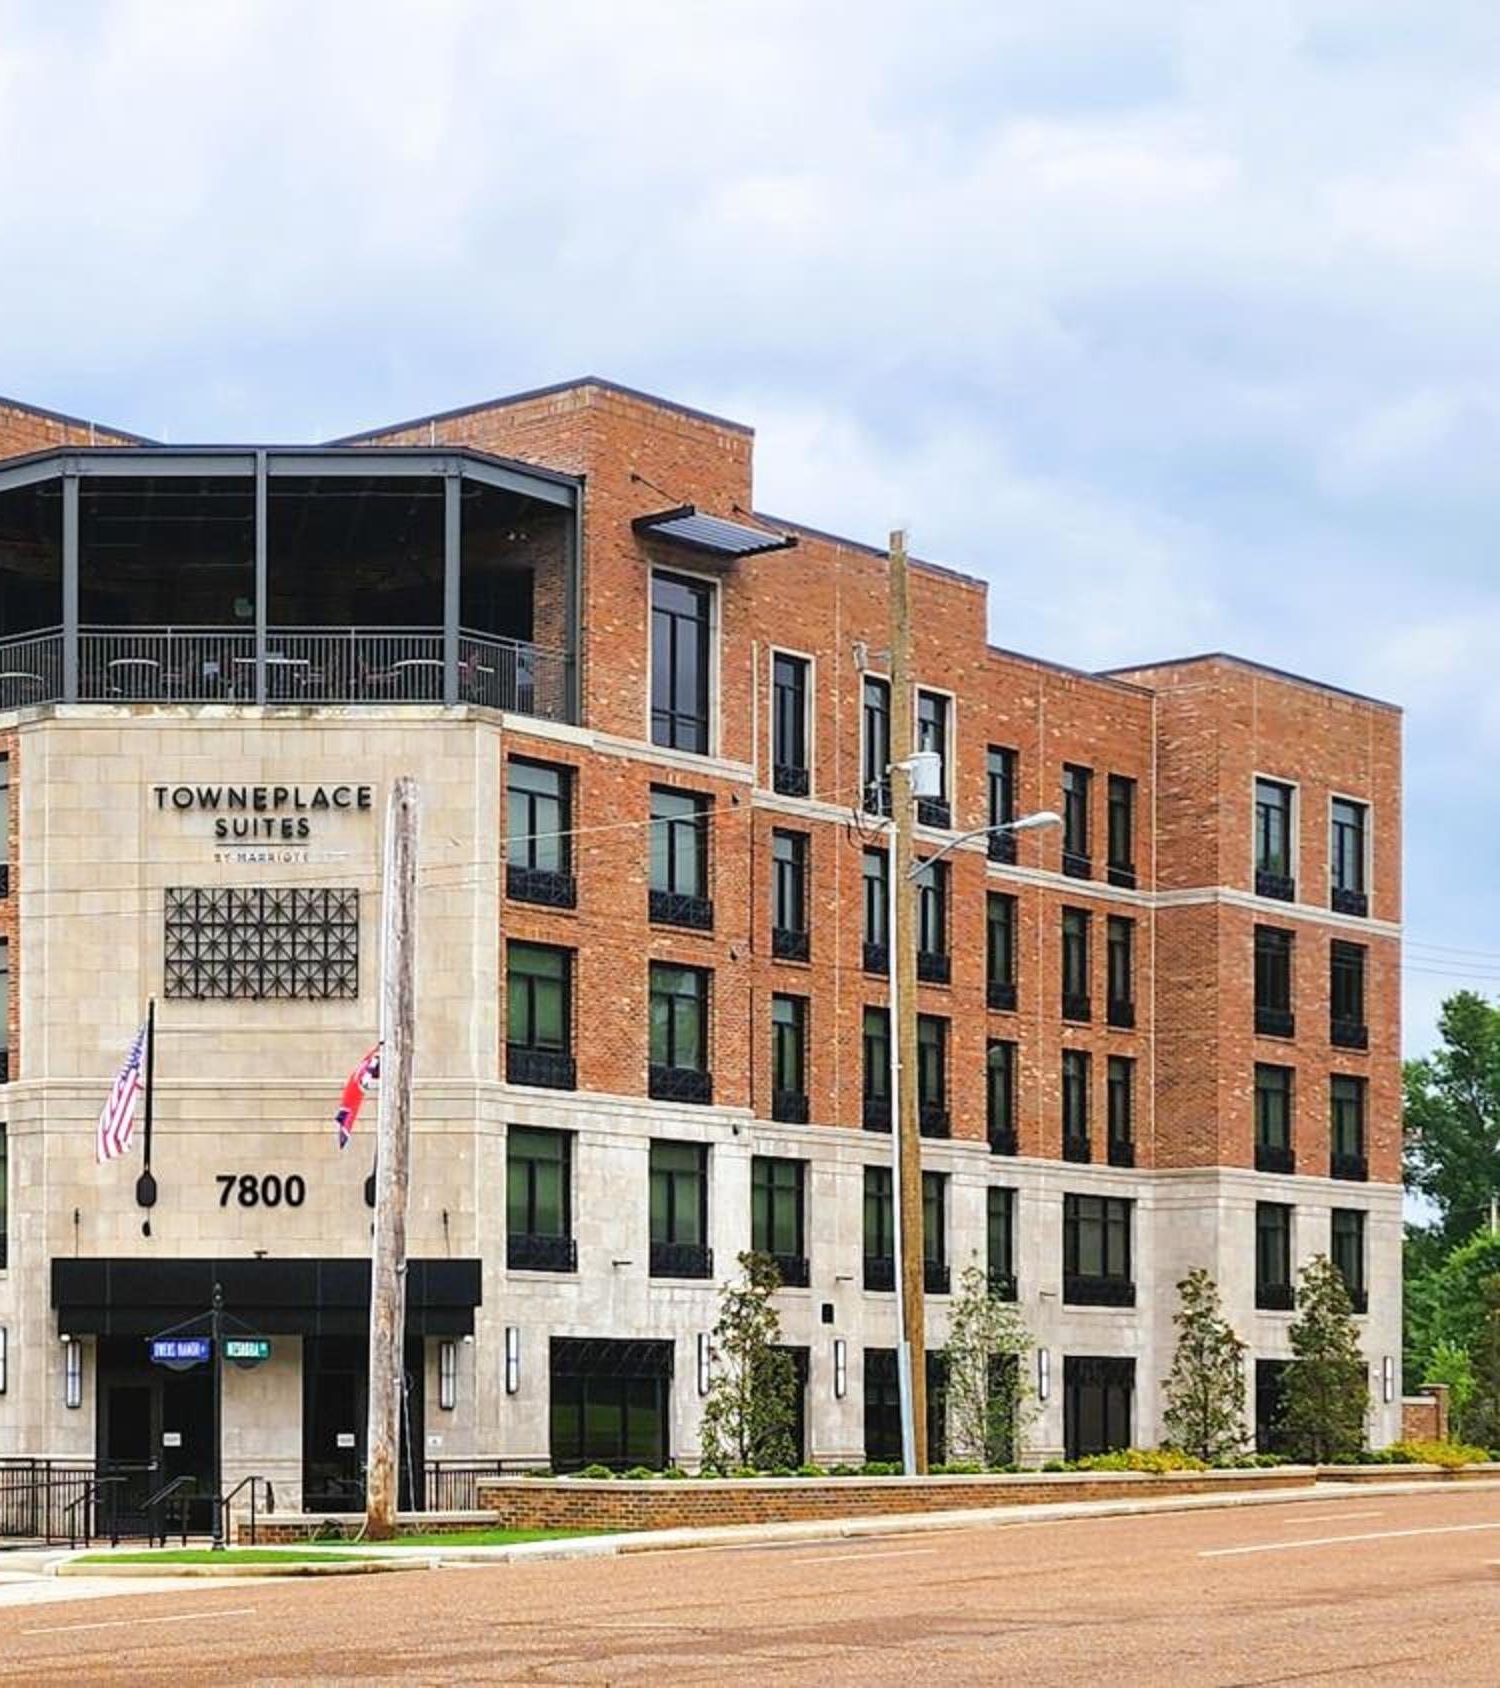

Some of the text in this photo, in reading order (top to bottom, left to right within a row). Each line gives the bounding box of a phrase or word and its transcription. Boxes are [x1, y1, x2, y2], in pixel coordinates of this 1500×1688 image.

[154, 786, 372, 811] TOWNEPLACE
[214, 817, 311, 839] SUITES
[213, 852, 230, 863] BY
[215, 1174, 306, 1208] 7800
